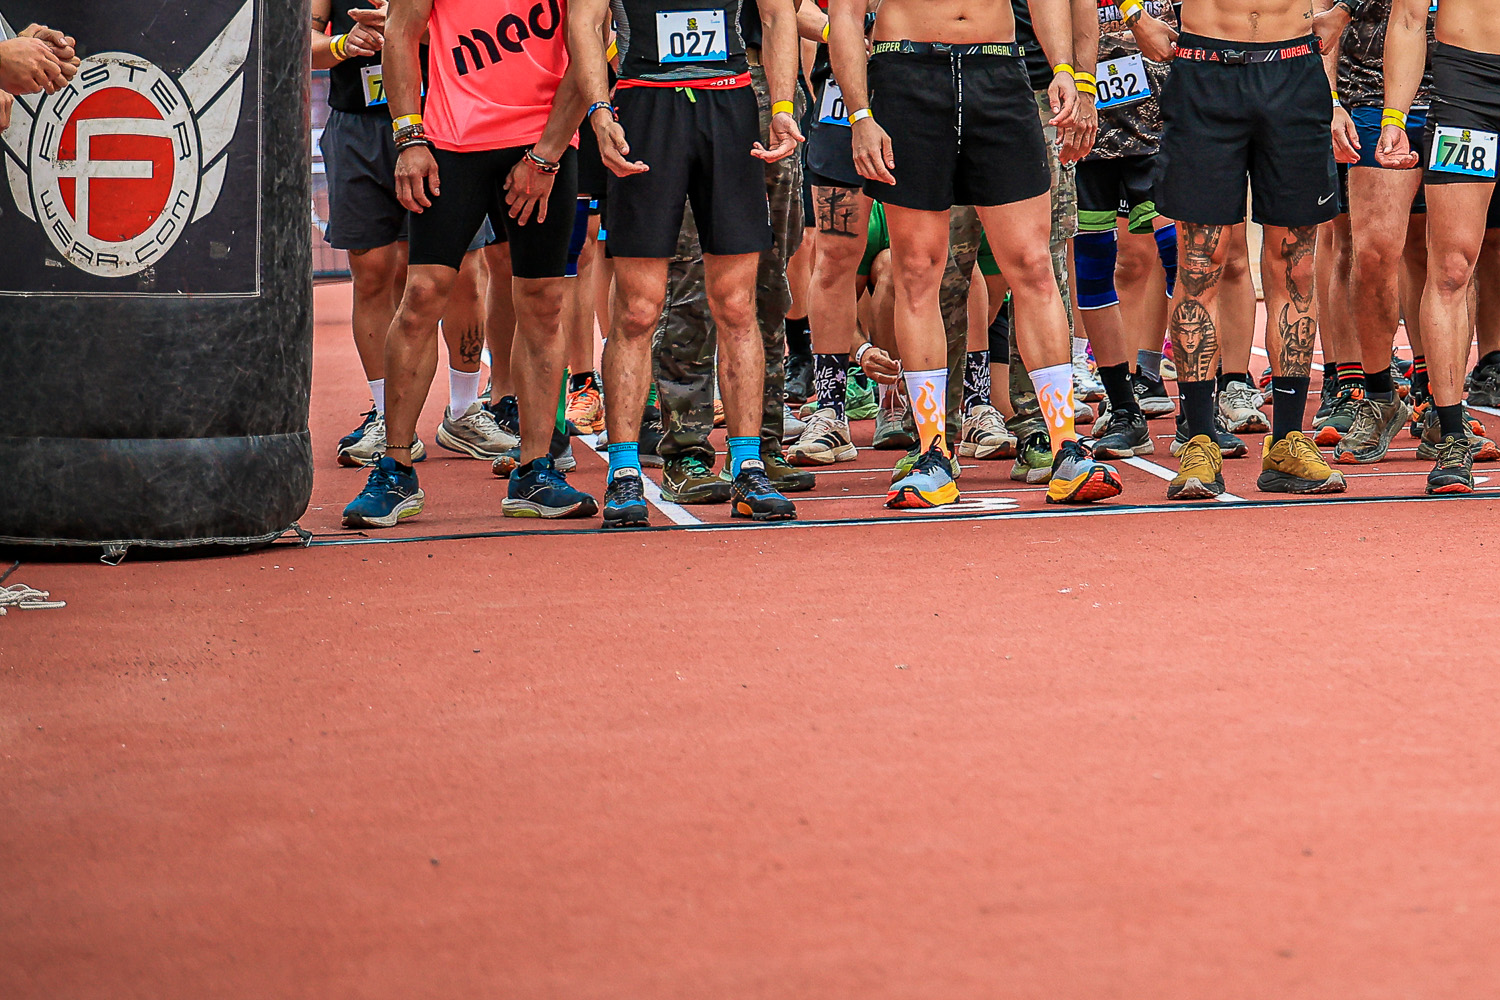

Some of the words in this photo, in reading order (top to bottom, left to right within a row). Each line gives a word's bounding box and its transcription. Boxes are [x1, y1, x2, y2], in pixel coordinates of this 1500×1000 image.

[670, 30, 717, 58] 027
[1178, 47, 1206, 62] KEEER
[1280, 43, 1311, 60] DORSAL
[1096, 72, 1141, 104] 032
[38, 61, 192, 162] FASTER
[1439, 141, 1487, 172] 748
[815, 378, 837, 390] ORE
